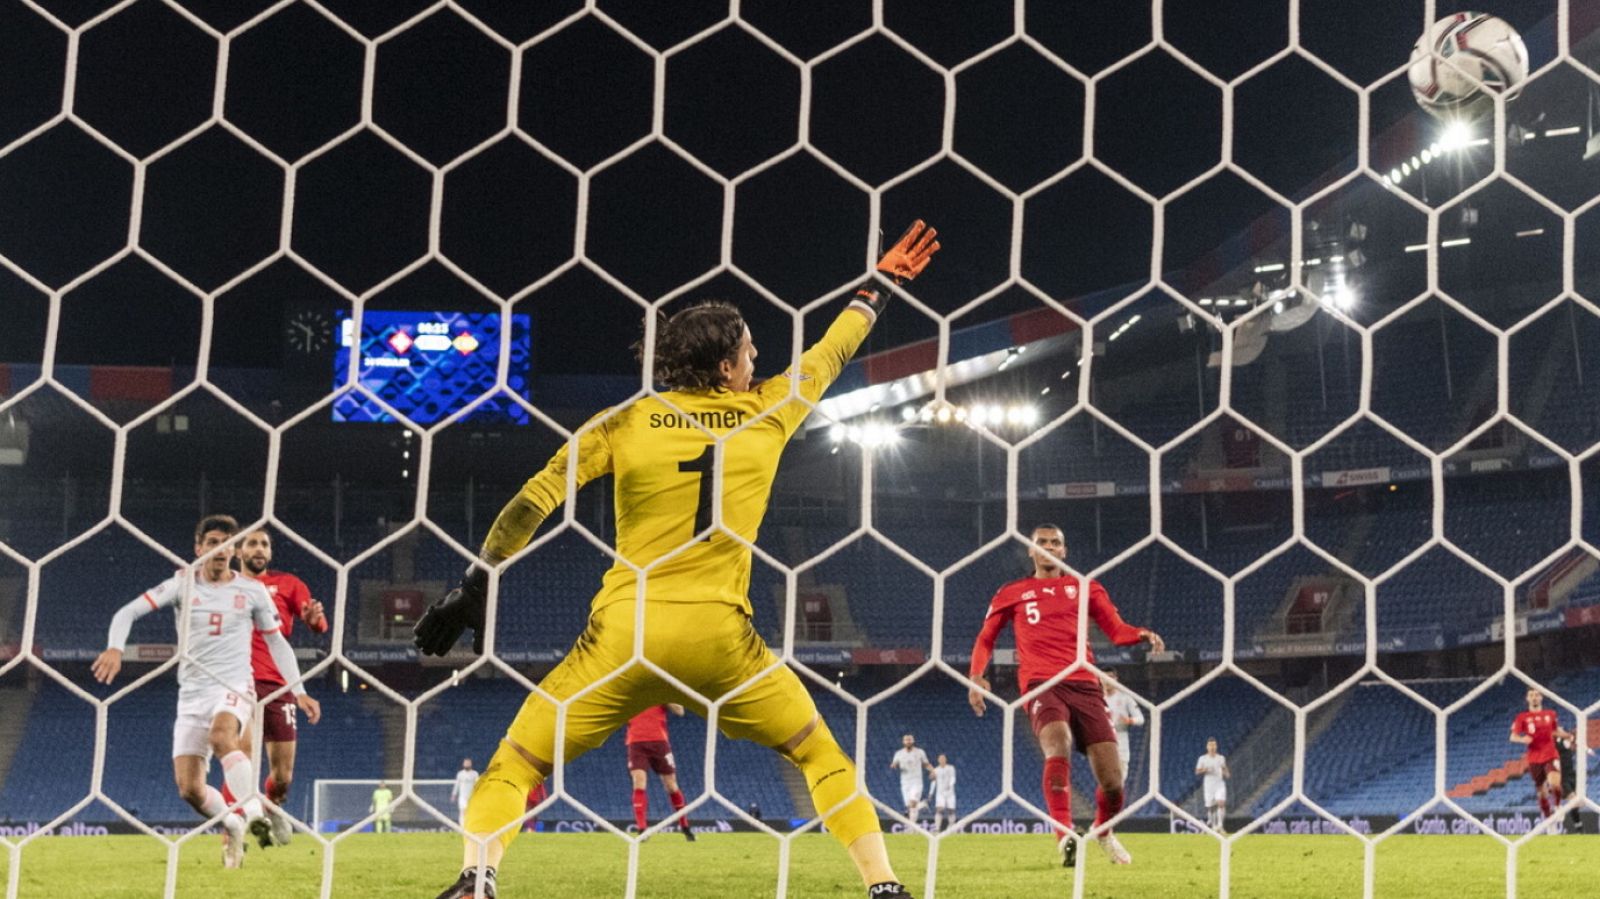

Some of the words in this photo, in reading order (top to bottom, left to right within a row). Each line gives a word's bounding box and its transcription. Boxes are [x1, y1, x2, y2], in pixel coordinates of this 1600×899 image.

[649, 409, 746, 429] sommer
[678, 444, 717, 542] 1
[1025, 602, 1040, 624] 5
[208, 613, 223, 636] 9
[60, 821, 108, 837] altro
[971, 819, 1027, 834] molto
[1497, 811, 1531, 834] molto
